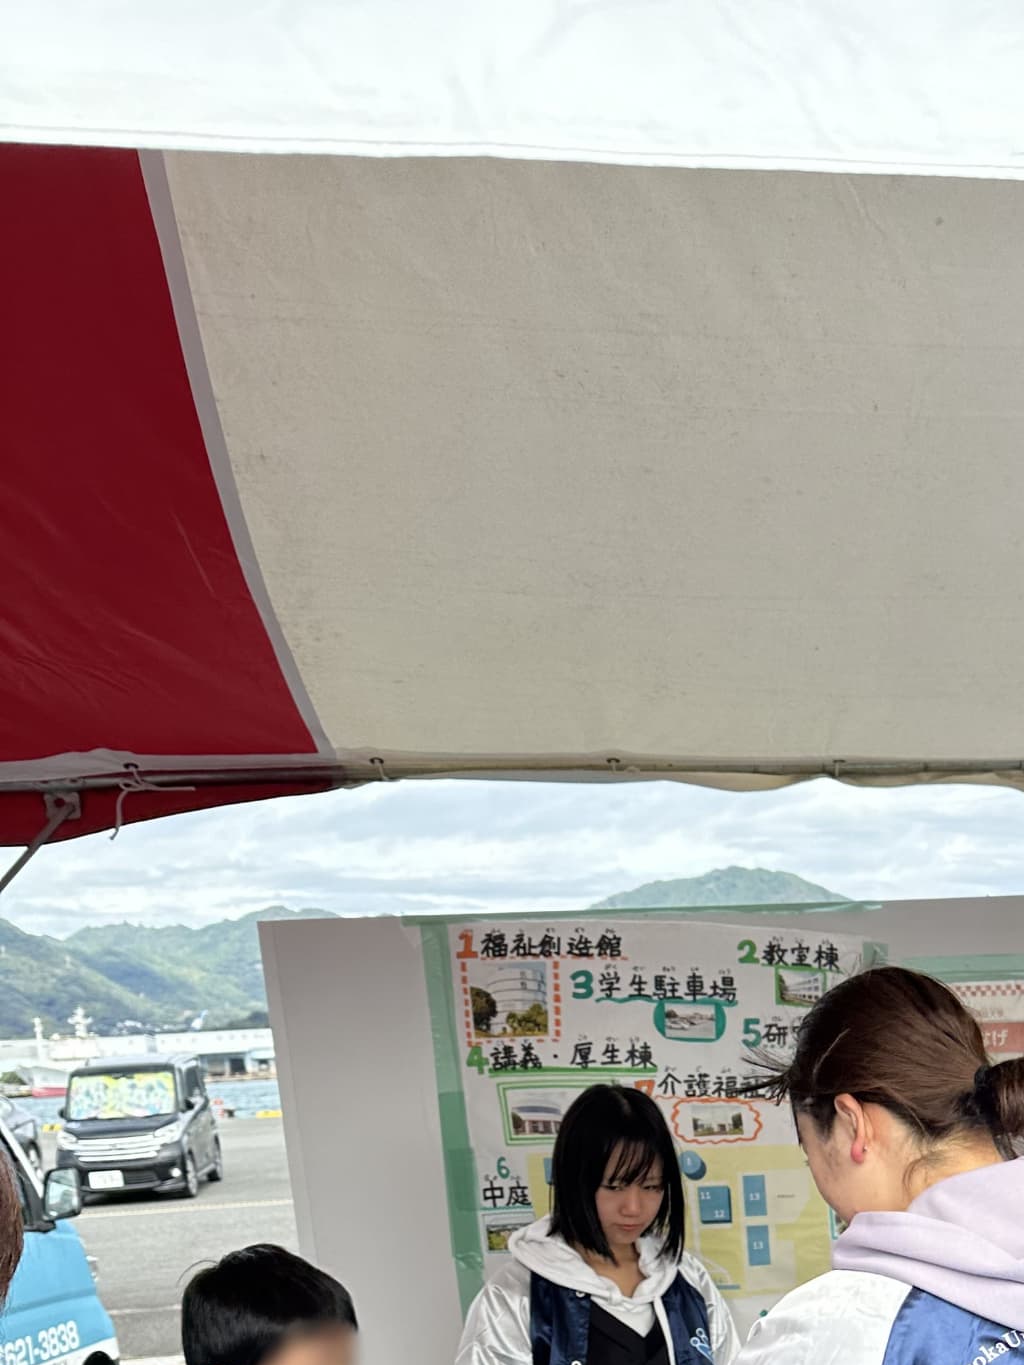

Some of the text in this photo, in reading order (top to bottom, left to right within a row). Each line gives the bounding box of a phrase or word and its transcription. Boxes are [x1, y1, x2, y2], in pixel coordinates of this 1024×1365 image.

[481, 934, 622, 957] 福祉創造館
[761, 941, 842, 973] 教室棟
[598, 972, 737, 1004] 学生駐車場
[482, 1180, 532, 1208] 中庭
